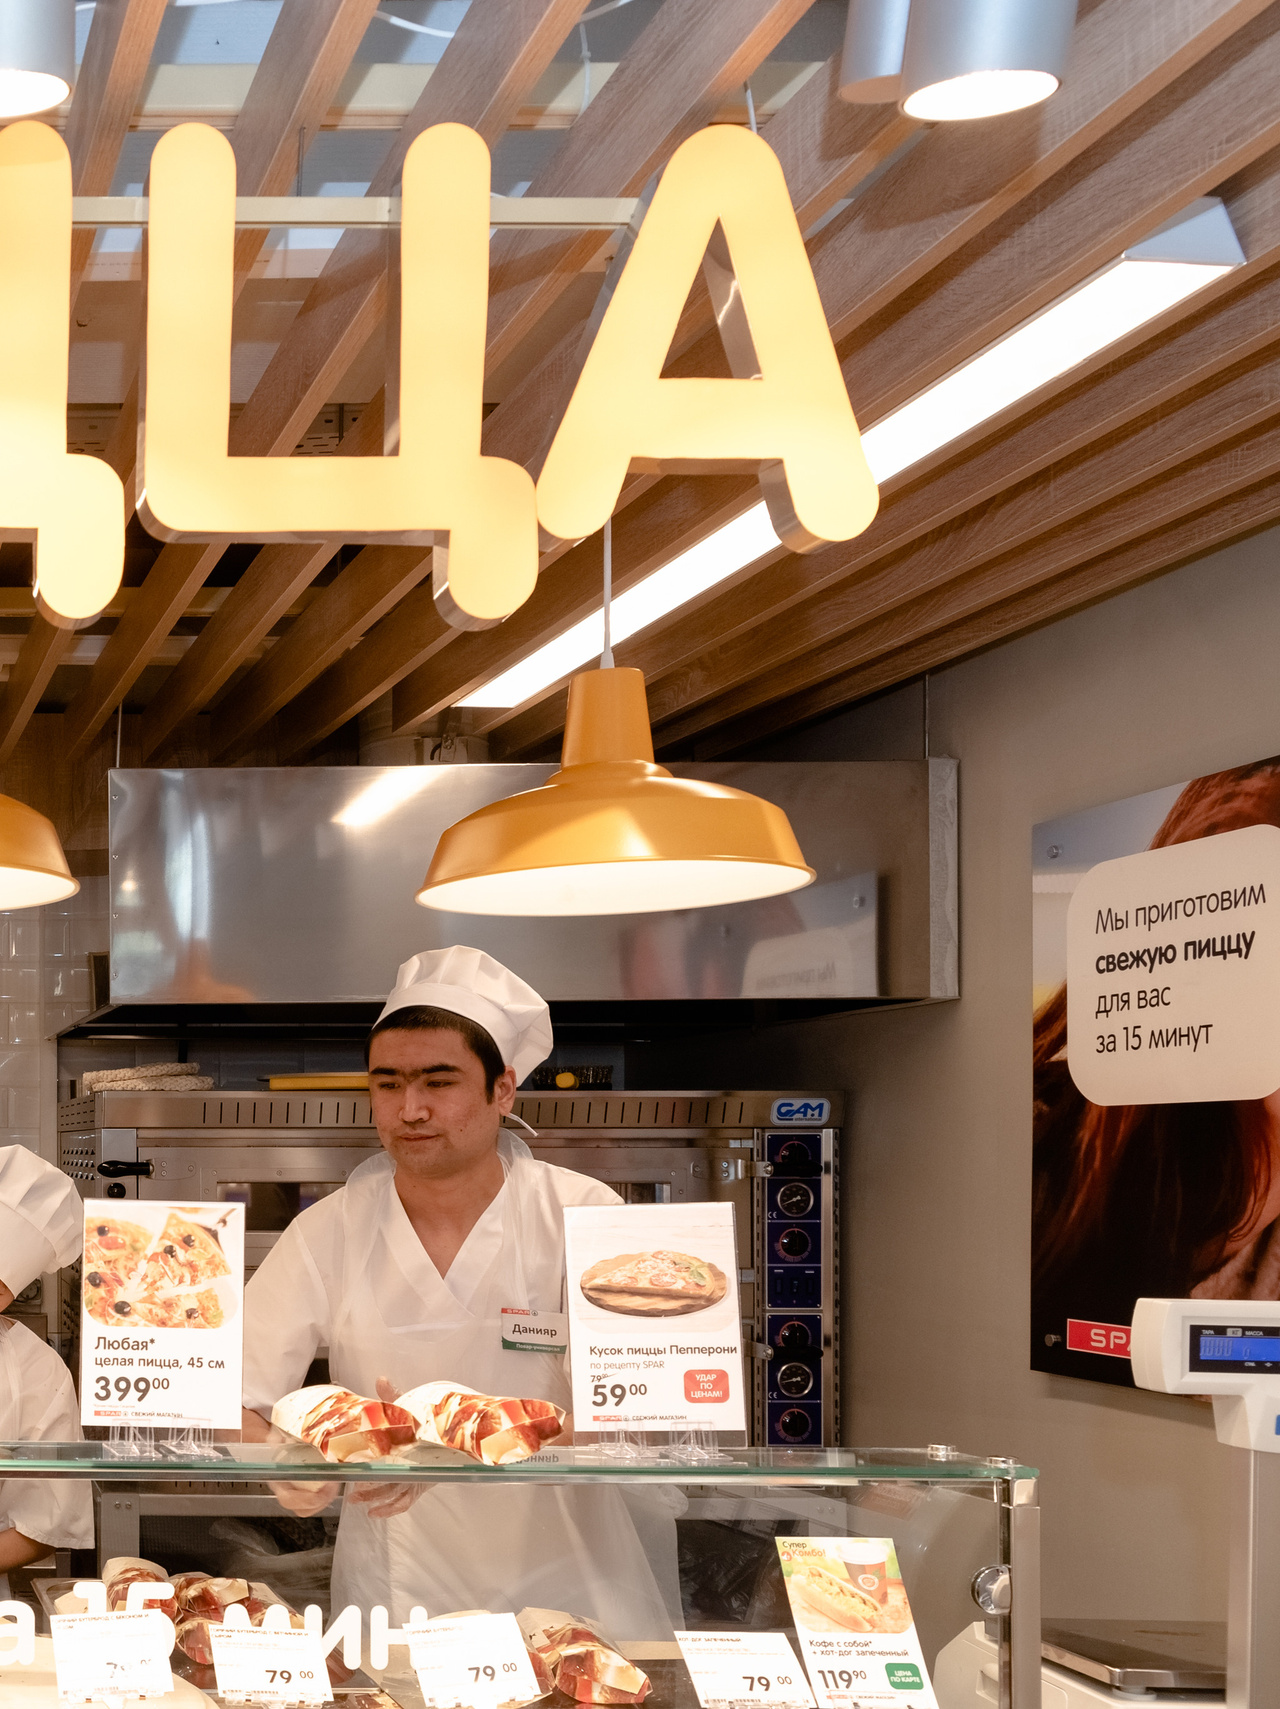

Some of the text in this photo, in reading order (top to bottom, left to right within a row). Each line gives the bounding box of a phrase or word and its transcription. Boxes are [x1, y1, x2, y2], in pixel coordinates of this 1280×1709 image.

[1096, 884, 1266, 934] Мы приготовим
[1095, 931, 1255, 973] свежую пиццу
[1096, 987, 1171, 1019] для вас
[1096, 1024, 1213, 1053] за 15 минут
[777, 1103, 824, 1117] GAM
[513, 1324, 557, 1338] Данияр
[590, 1345, 737, 1358] Кусок пиццы Пепперони
[95, 1356, 225, 1369] целая пицца, 45 см
[589, 1361, 664, 1371] по рецепту SPAR
[694, 1373, 717, 1382] УДАР
[699, 1382, 713, 1390] ПО
[690, 1390, 723, 1399] ЦЕНАМ!
[130, 1409, 155, 1418] СВЕЖИЙ
[782, 1541, 807, 1549] Супер
[792, 1549, 826, 1557] Комбо!
[810, 1640, 834, 1648] Кофе
[820, 1649, 909, 1657] хот-дог запеченный
[265, 1670, 314, 1684] 79 00
[468, 1663, 517, 1683] 79 00
[893, 1669, 913, 1677] ЦЕНА
[742, 1676, 792, 1691] 79 00
